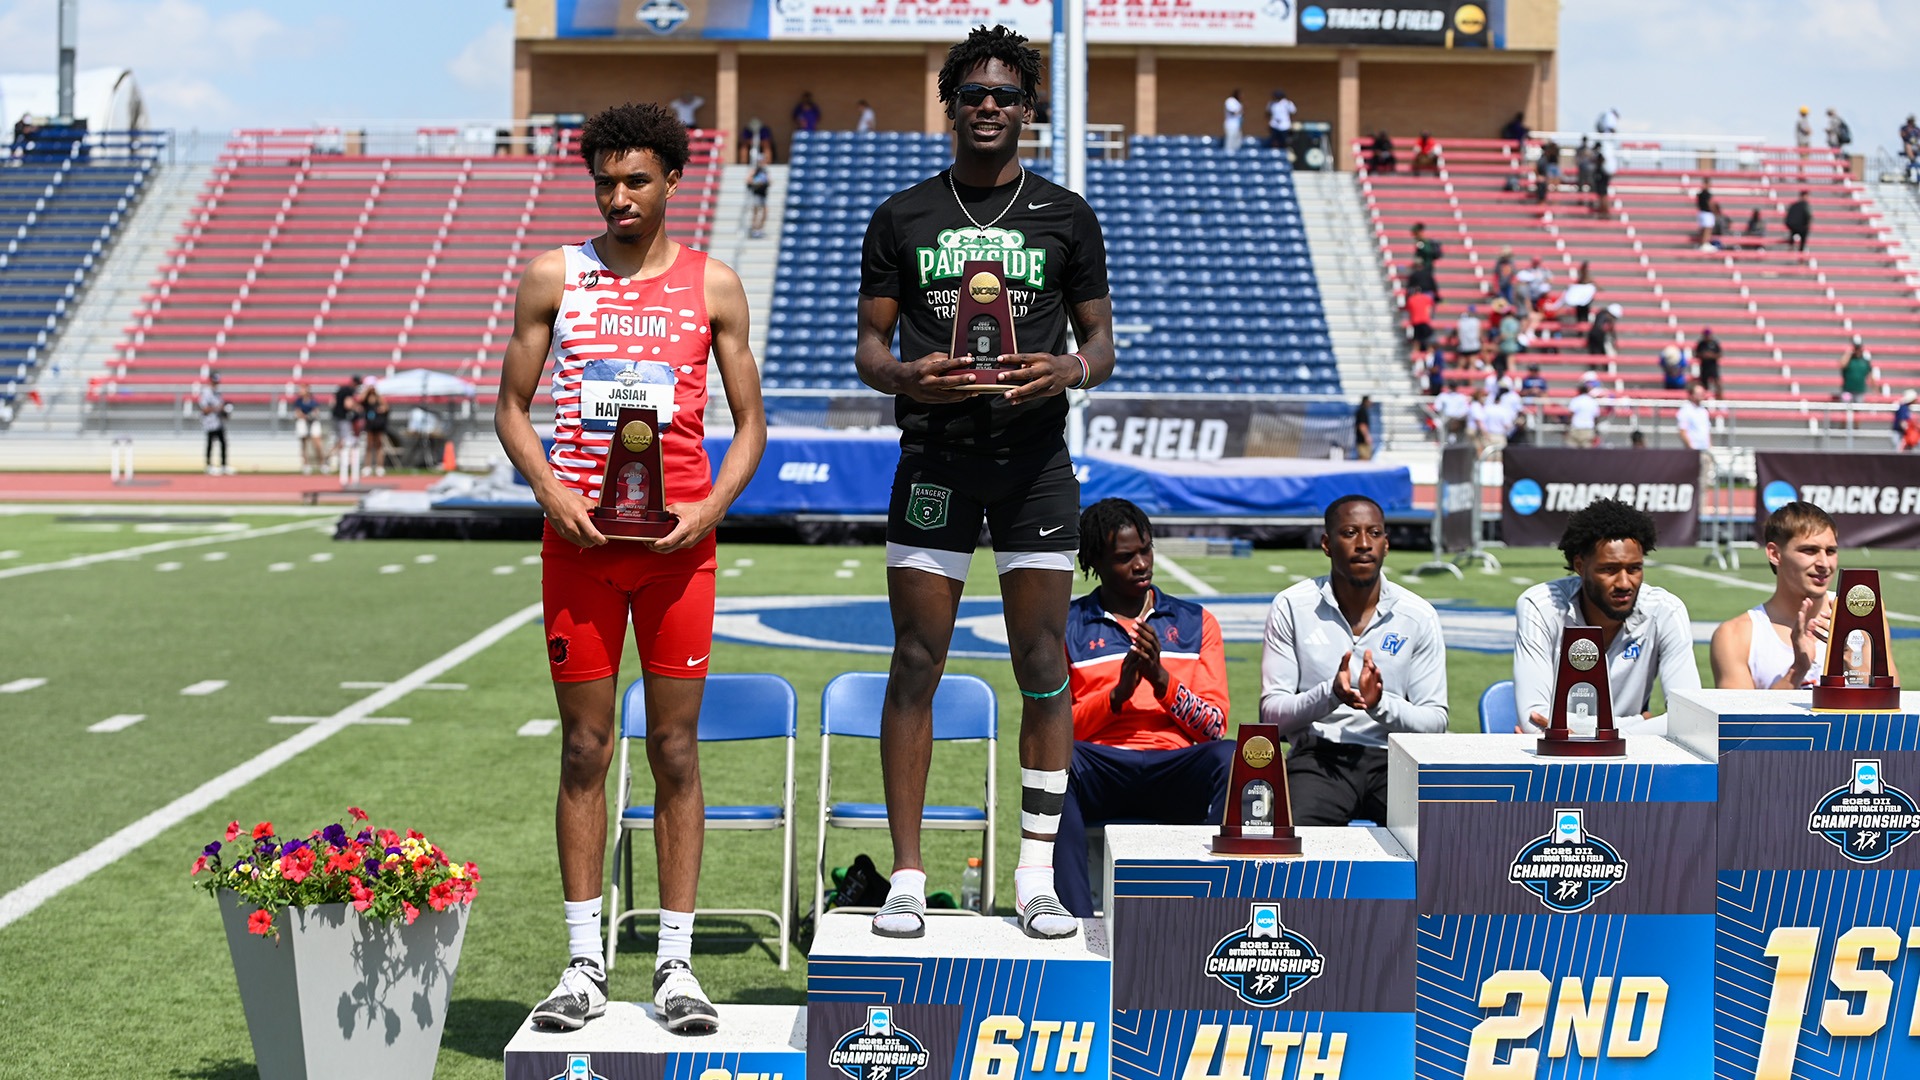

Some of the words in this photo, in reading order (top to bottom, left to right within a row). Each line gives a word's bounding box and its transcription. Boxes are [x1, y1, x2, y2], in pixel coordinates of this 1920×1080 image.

[1326, 8, 1381, 29] TRACK
[1397, 9, 1445, 31] FIELD
[926, 290, 958, 305] CROS
[934, 305, 957, 319] TRA
[600, 313, 667, 338] MSUM
[608, 388, 647, 401] JASIAH
[1121, 416, 1229, 459] FIELD
[915, 487, 946, 500] RANGERS
[1636, 483, 1694, 512] FIELD
[1800, 485, 1879, 514] TRACK
[1812, 815, 1920, 829] CHAMPIONSHIPS
[1513, 864, 1624, 878] CHAMPIONSHIPS
[1258, 949, 1277, 957] TRACK
[1283, 949, 1301, 957] FIELD
[1209, 958, 1321, 973] CHAMPIONSHIPS
[1463, 969, 1669, 1080] 2ND
[968, 1015, 1096, 1080] 6TH
[832, 1051, 925, 1066] CHAMPIONSHIPS
